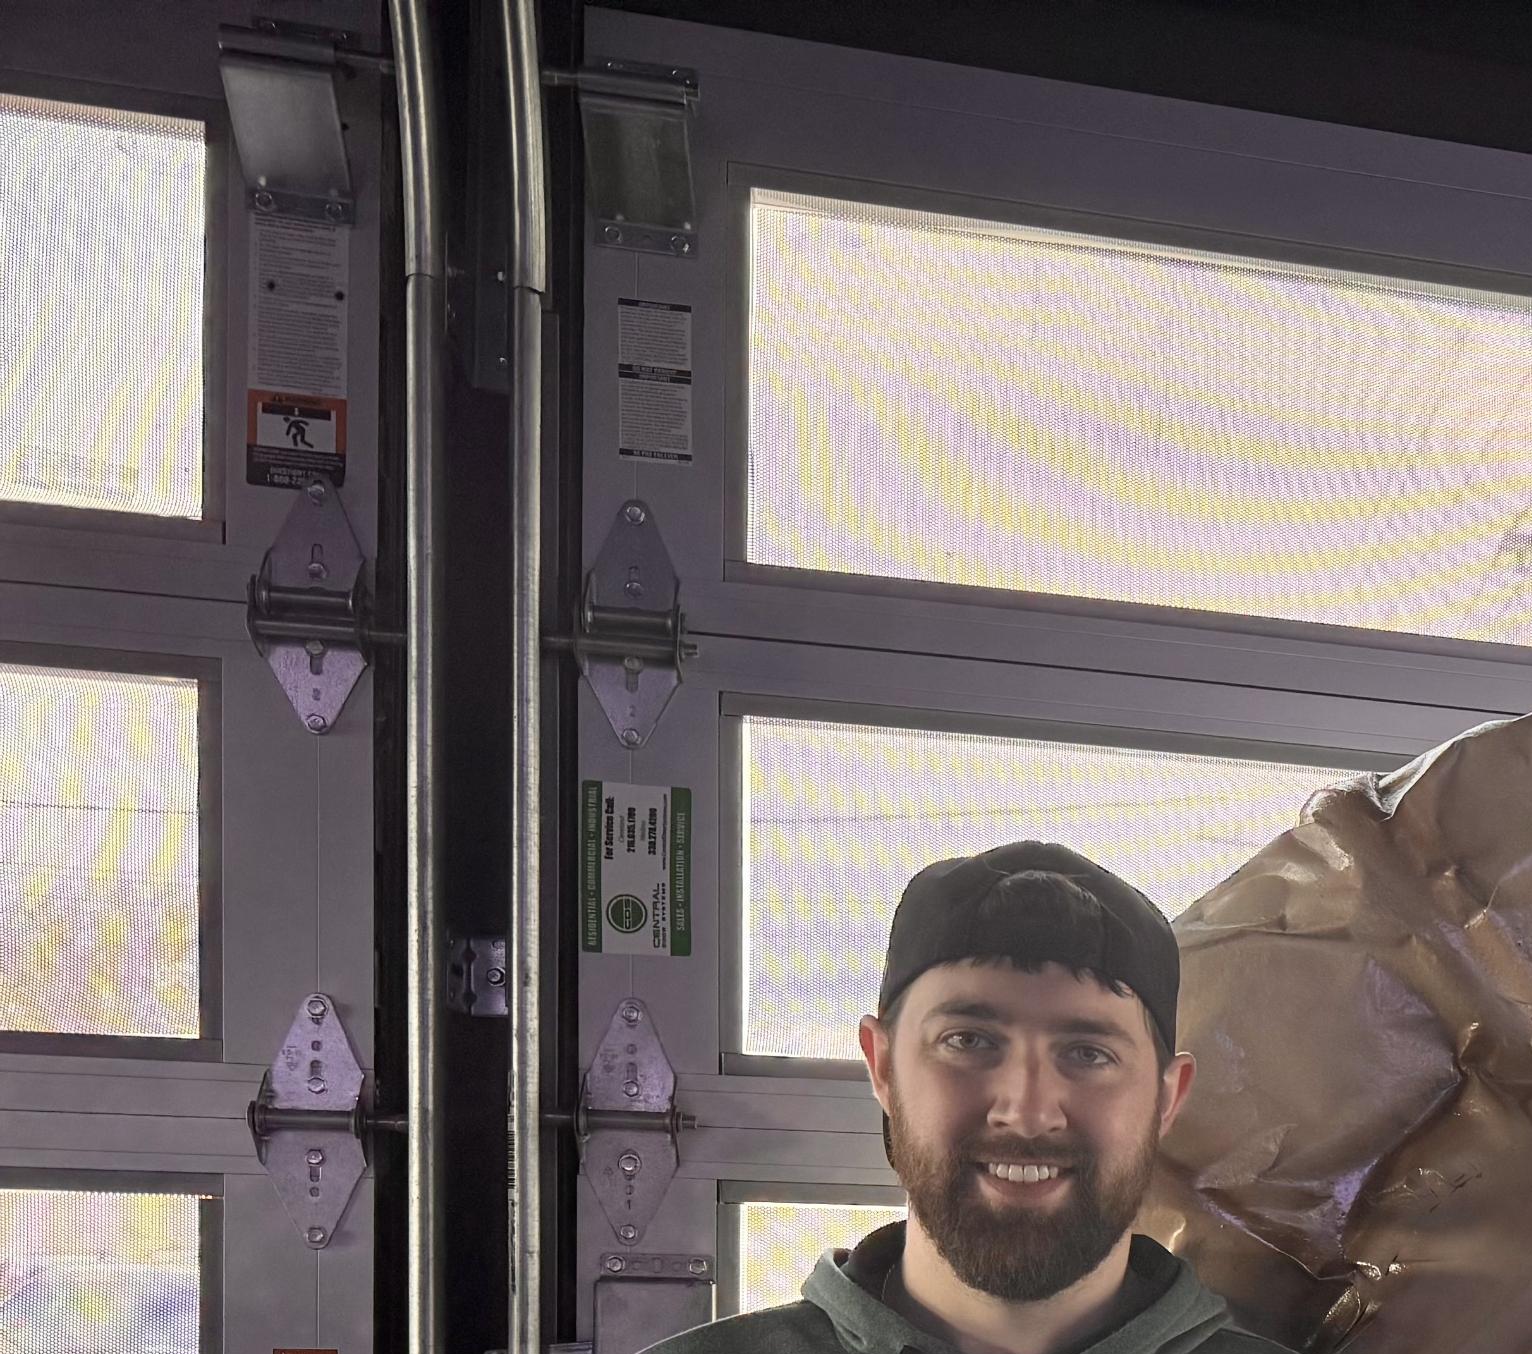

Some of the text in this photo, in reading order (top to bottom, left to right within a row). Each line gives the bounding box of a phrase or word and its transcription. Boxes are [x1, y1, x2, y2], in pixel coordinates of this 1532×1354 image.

[604, 816, 614, 846] Service
[604, 847, 614, 860] For
[587, 787, 597, 946] RESIDENTIAL COMMERCIAL INDUSTRIAL
[676, 811, 685, 931] SALES INSTALLATION SERVICE
[652, 883, 661, 948] CENTRAL
